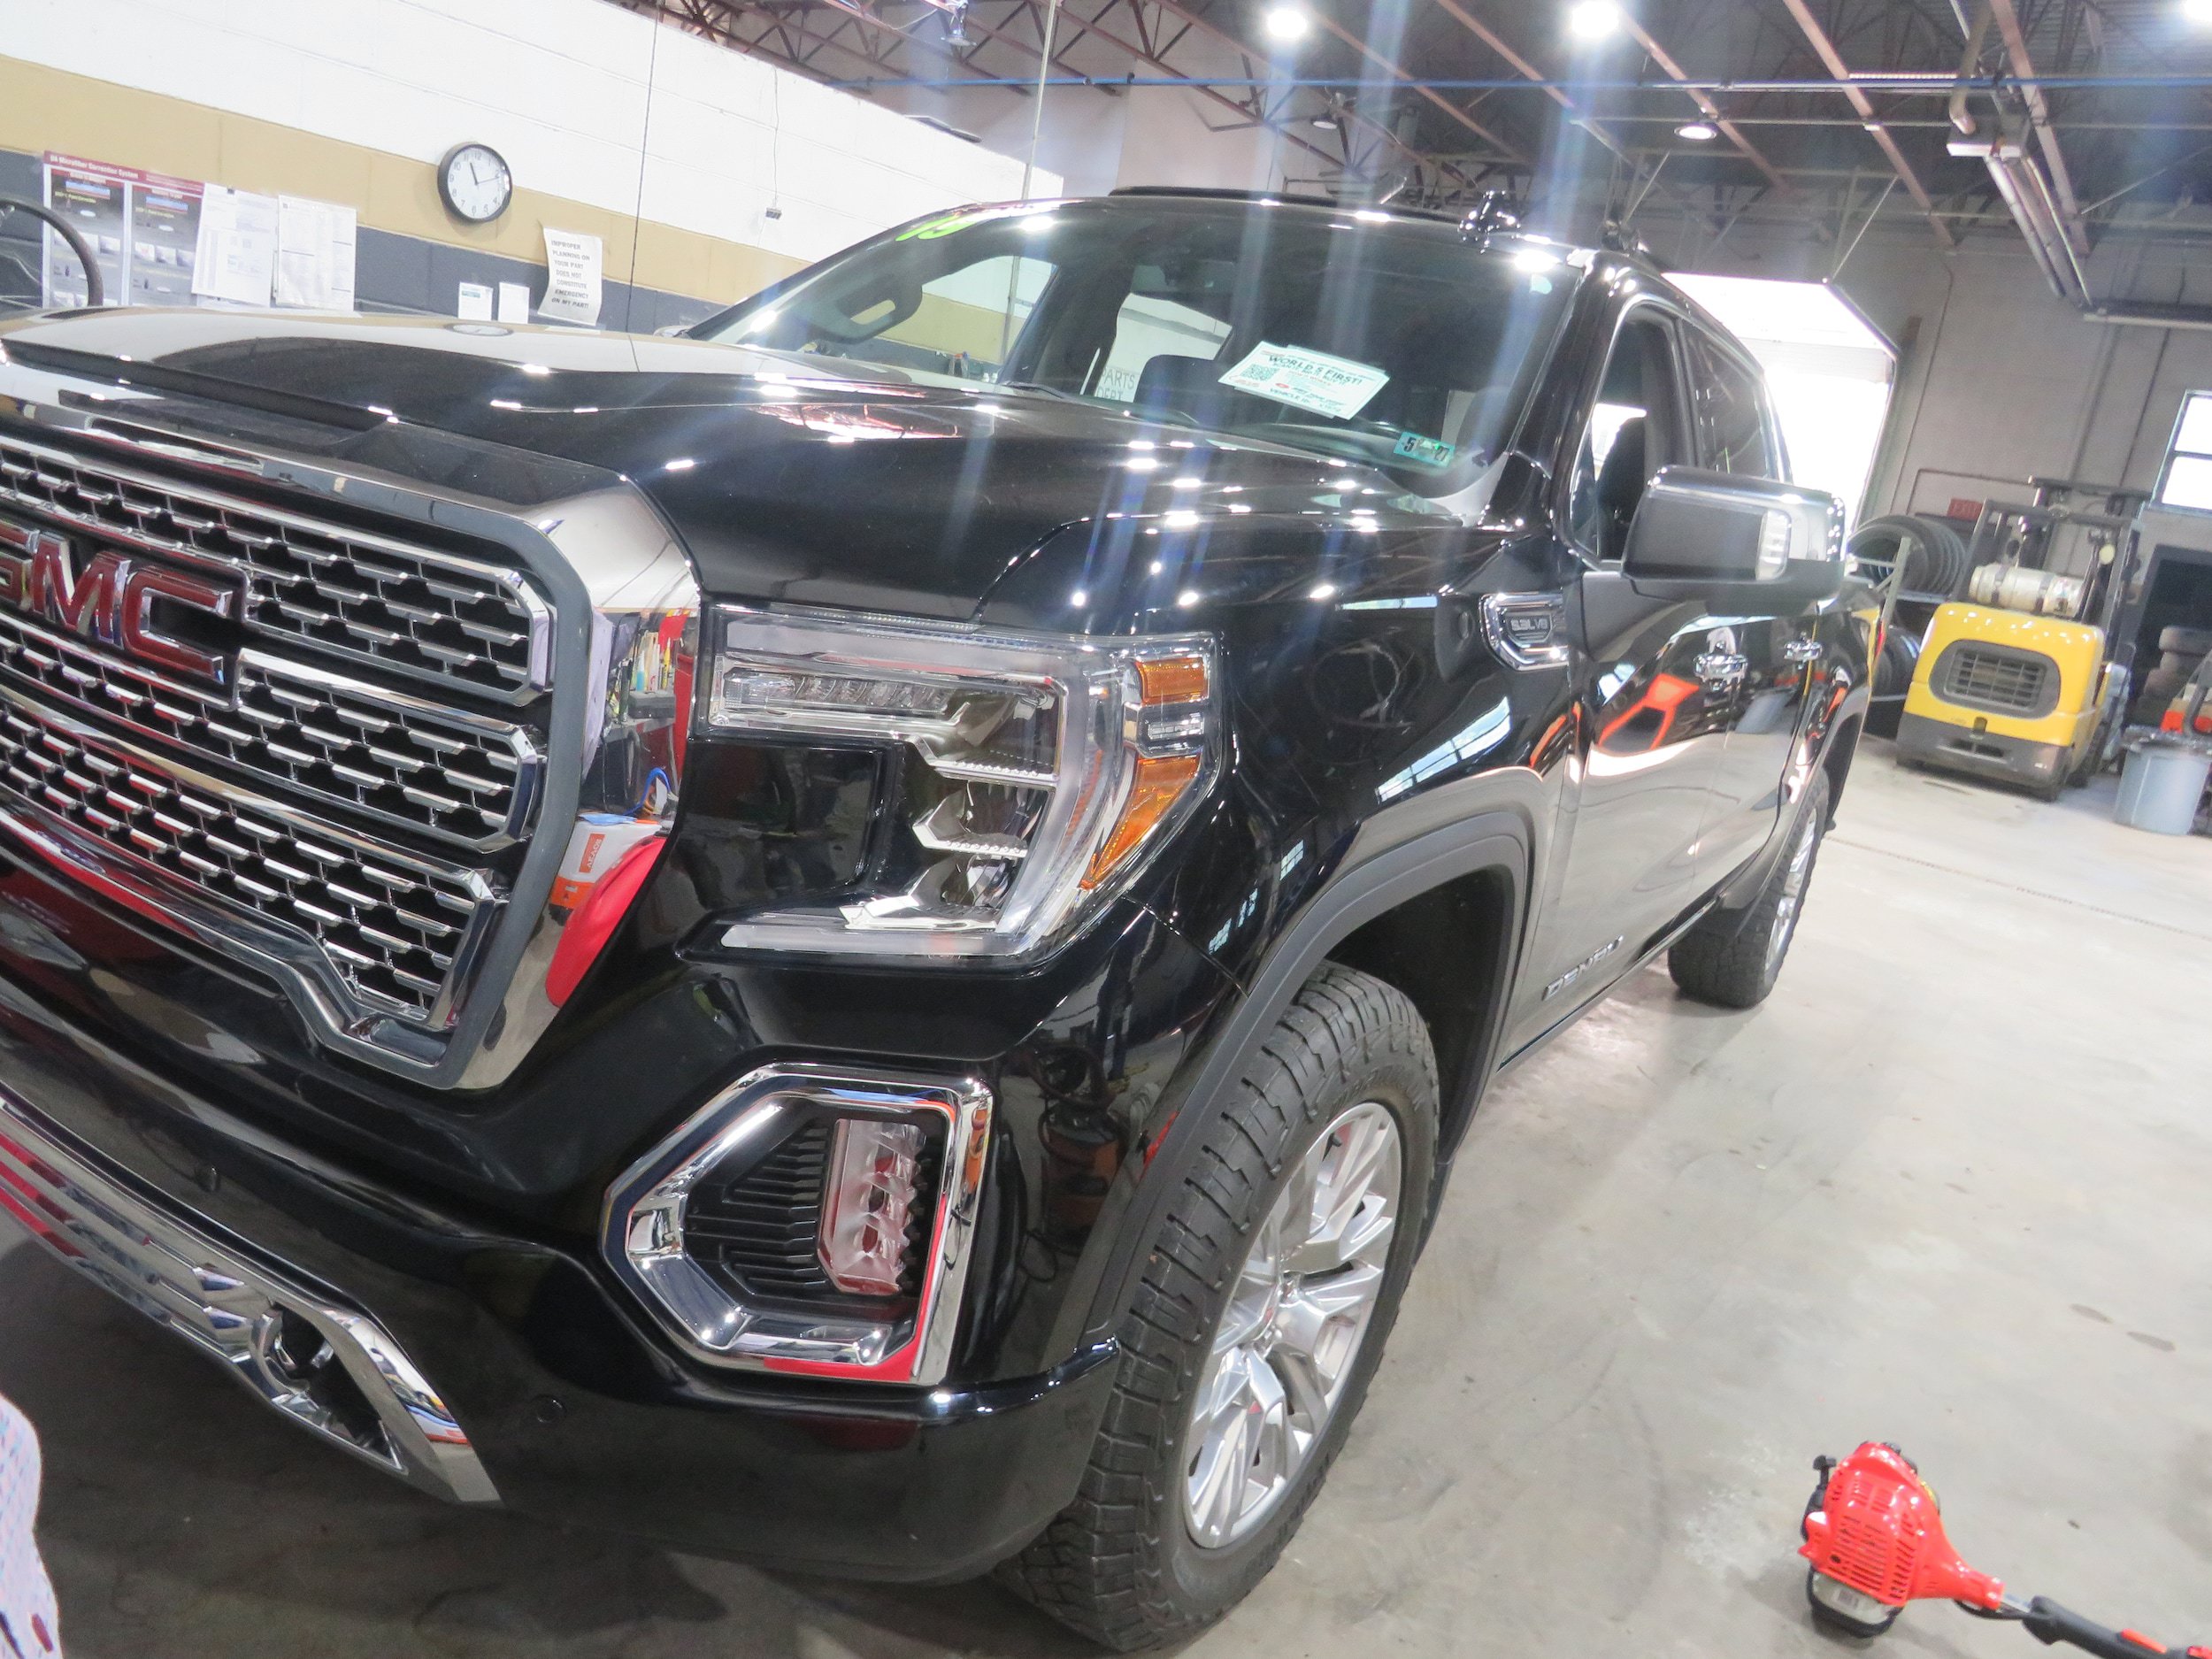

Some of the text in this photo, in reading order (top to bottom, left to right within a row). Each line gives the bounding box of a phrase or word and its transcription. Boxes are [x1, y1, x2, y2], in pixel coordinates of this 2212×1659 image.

[550, 240, 581, 250] IMPROPER
[552, 250, 580, 260] PLANNING
[570, 261, 584, 270] PART
[556, 269, 582, 280] DOES NOT
[557, 279, 588, 289] CONSTITUTE
[554, 288, 589, 300] EMERGENCY
[572, 301, 589, 310] PART!
[1327, 368, 1363, 387] FIRST!
[1403, 436, 1417, 453] 5
